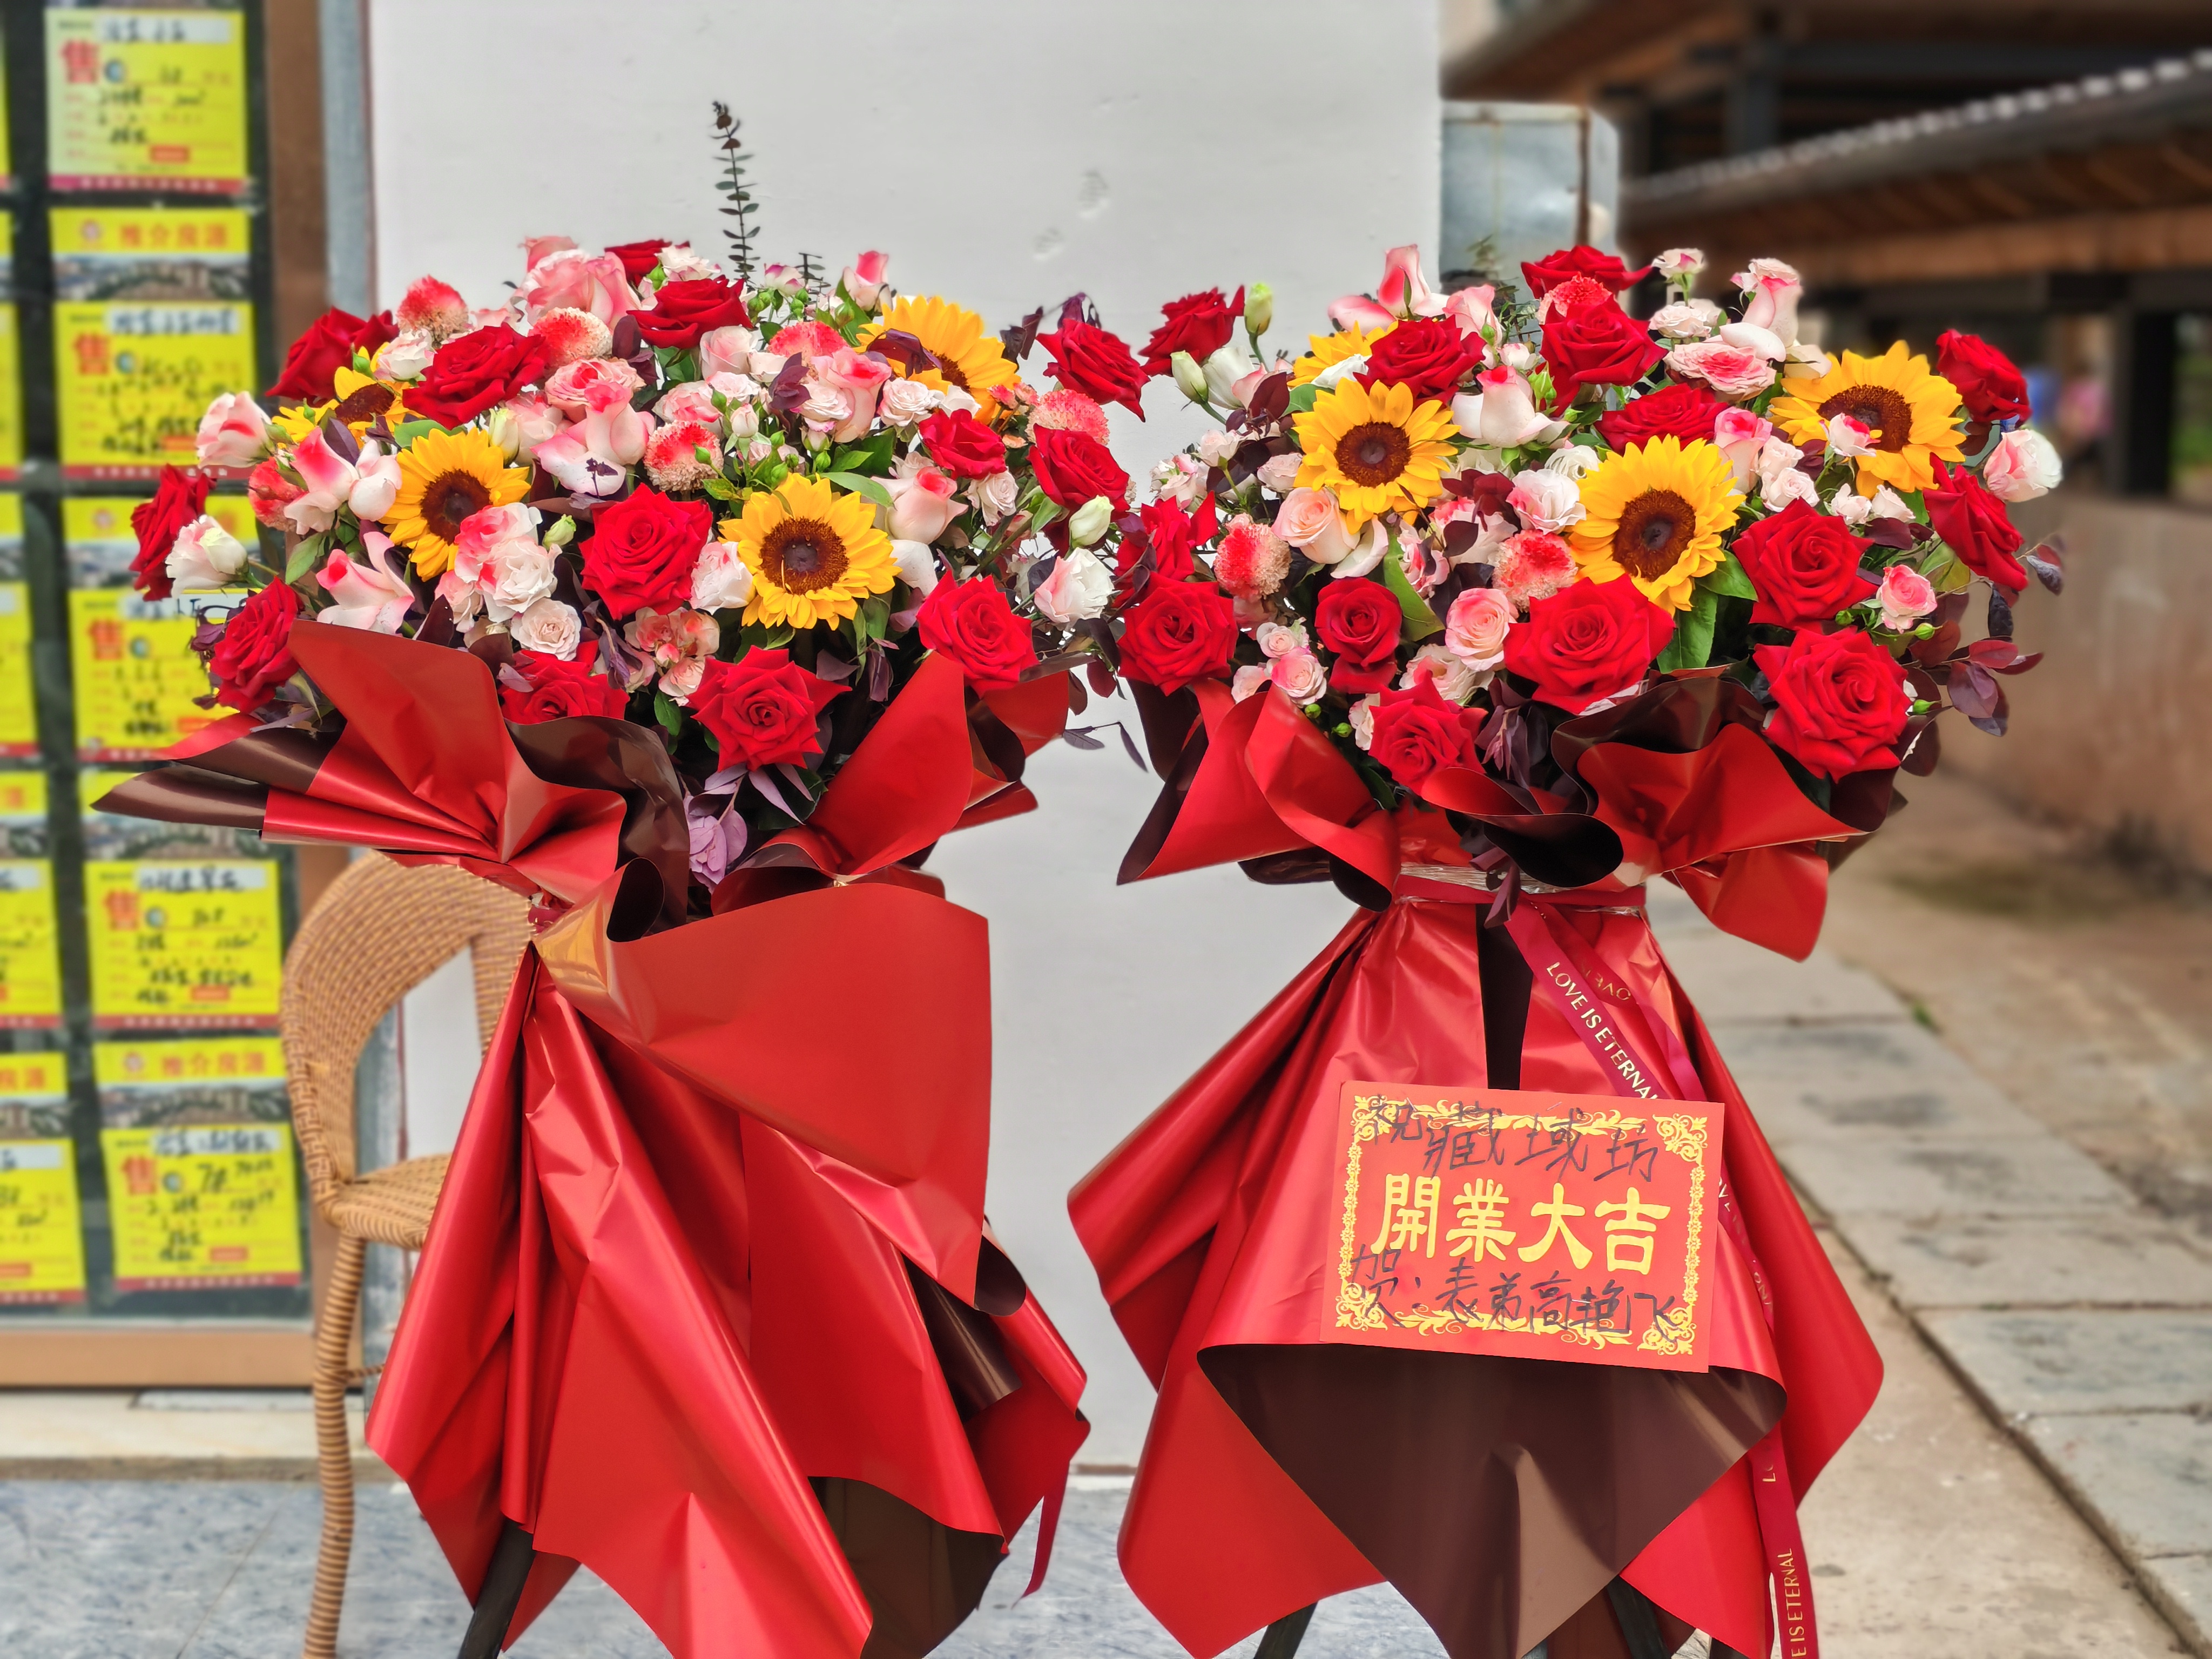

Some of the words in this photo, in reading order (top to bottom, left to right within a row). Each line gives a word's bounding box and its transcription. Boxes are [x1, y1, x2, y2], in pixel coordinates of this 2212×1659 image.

[1546, 961, 1588, 1010] LOVE
[1581, 1008, 1602, 1029] IS
[1371, 1173, 1671, 1275] 開業大吉
[1777, 1548, 1803, 1621] ETERNAL
[1789, 1625, 1805, 1642] IS
